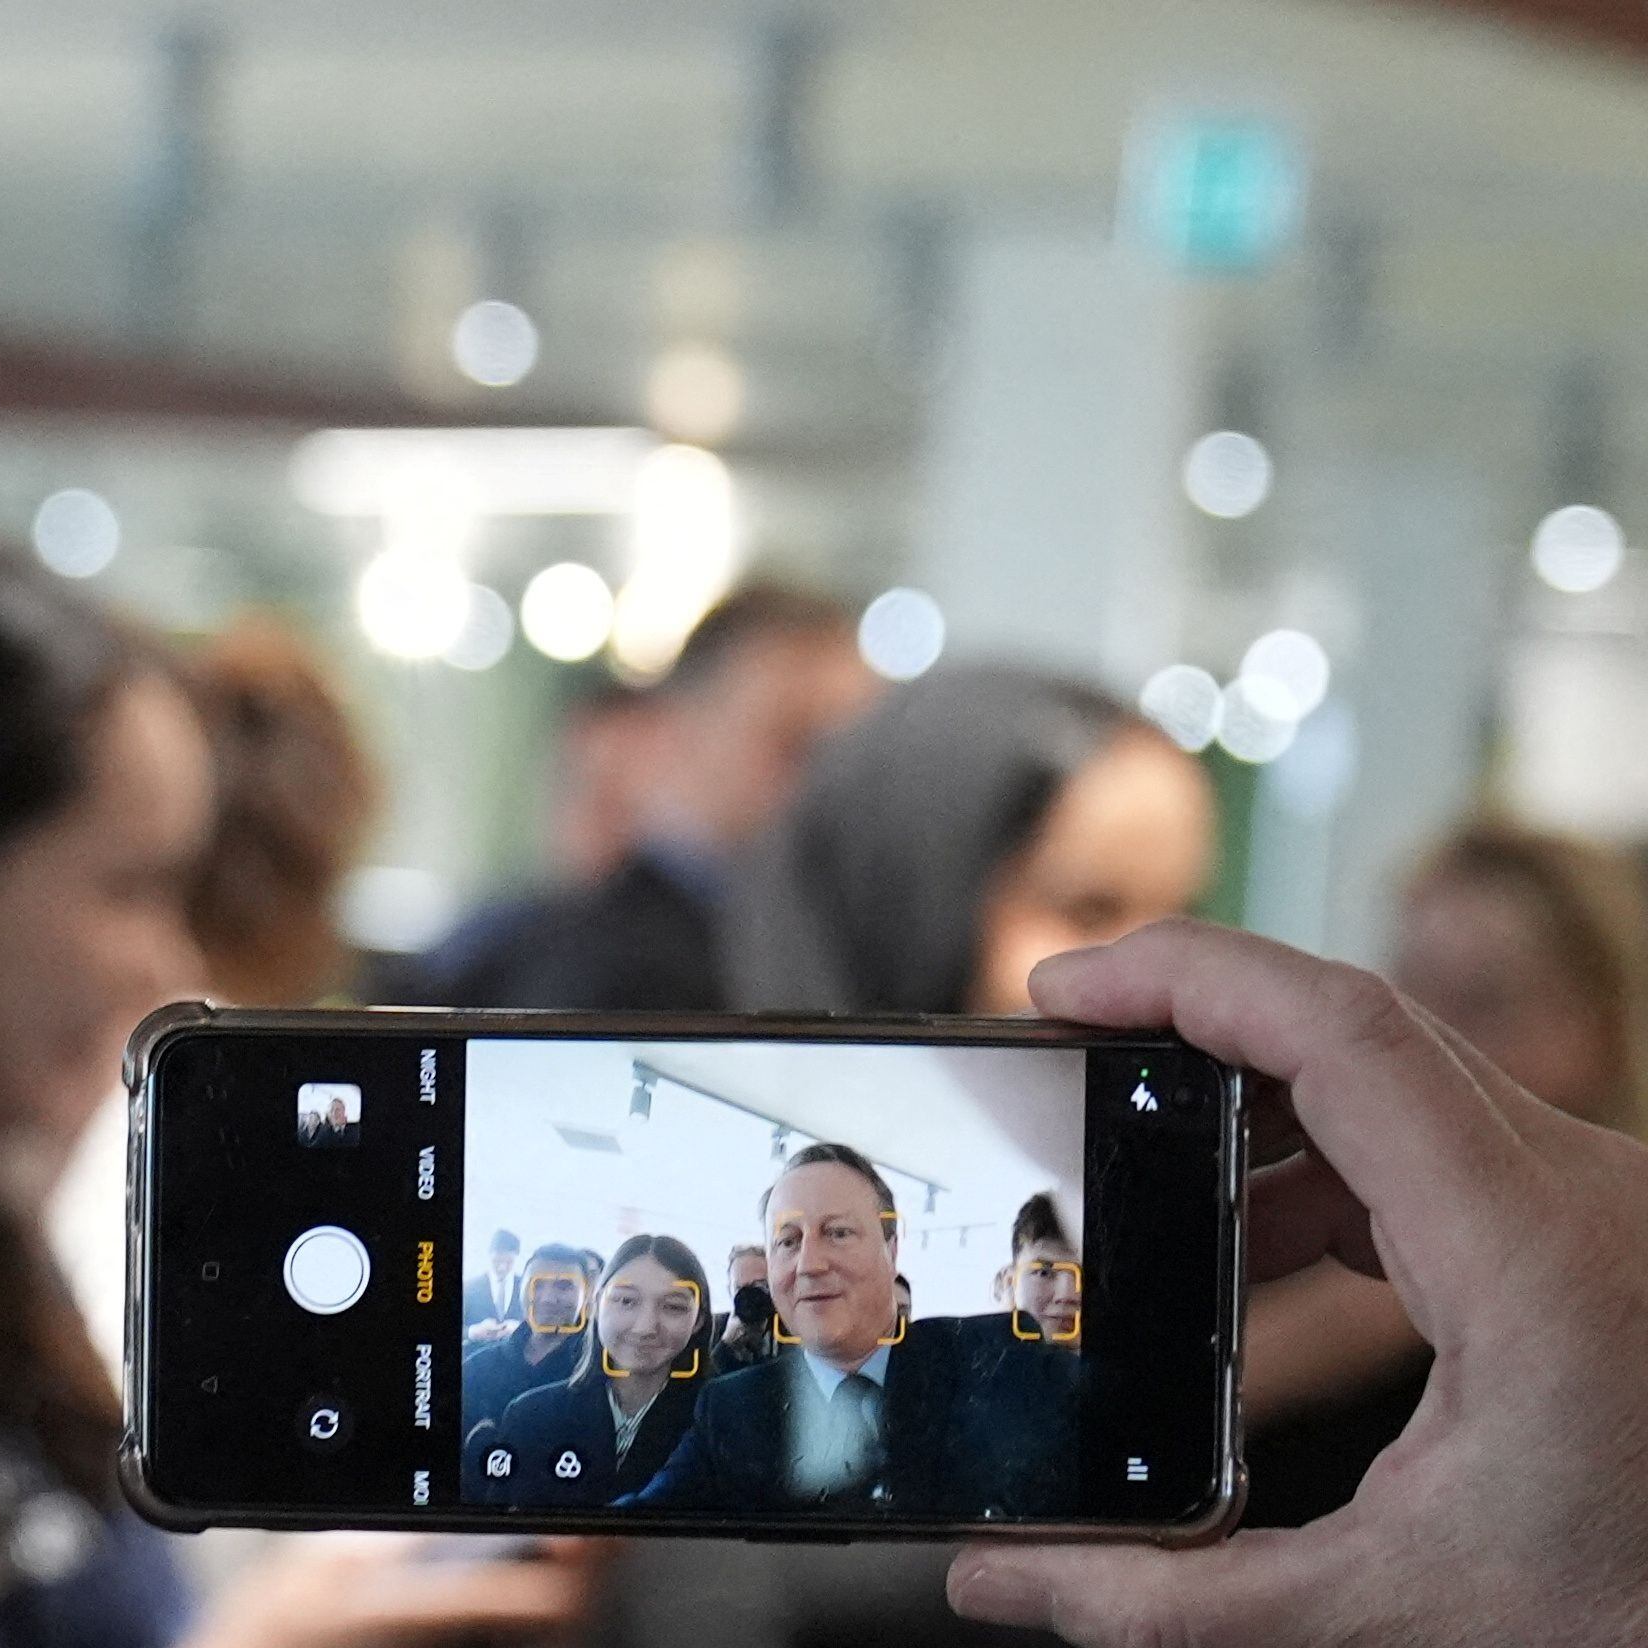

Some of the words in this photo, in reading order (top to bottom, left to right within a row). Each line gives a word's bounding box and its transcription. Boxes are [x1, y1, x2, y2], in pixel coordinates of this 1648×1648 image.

[419, 1048, 437, 1106] NIGHT
[417, 1145, 435, 1202] VIDEO
[416, 1240, 434, 1304] PHOTO
[414, 1344, 432, 1431] PORTRAIT
